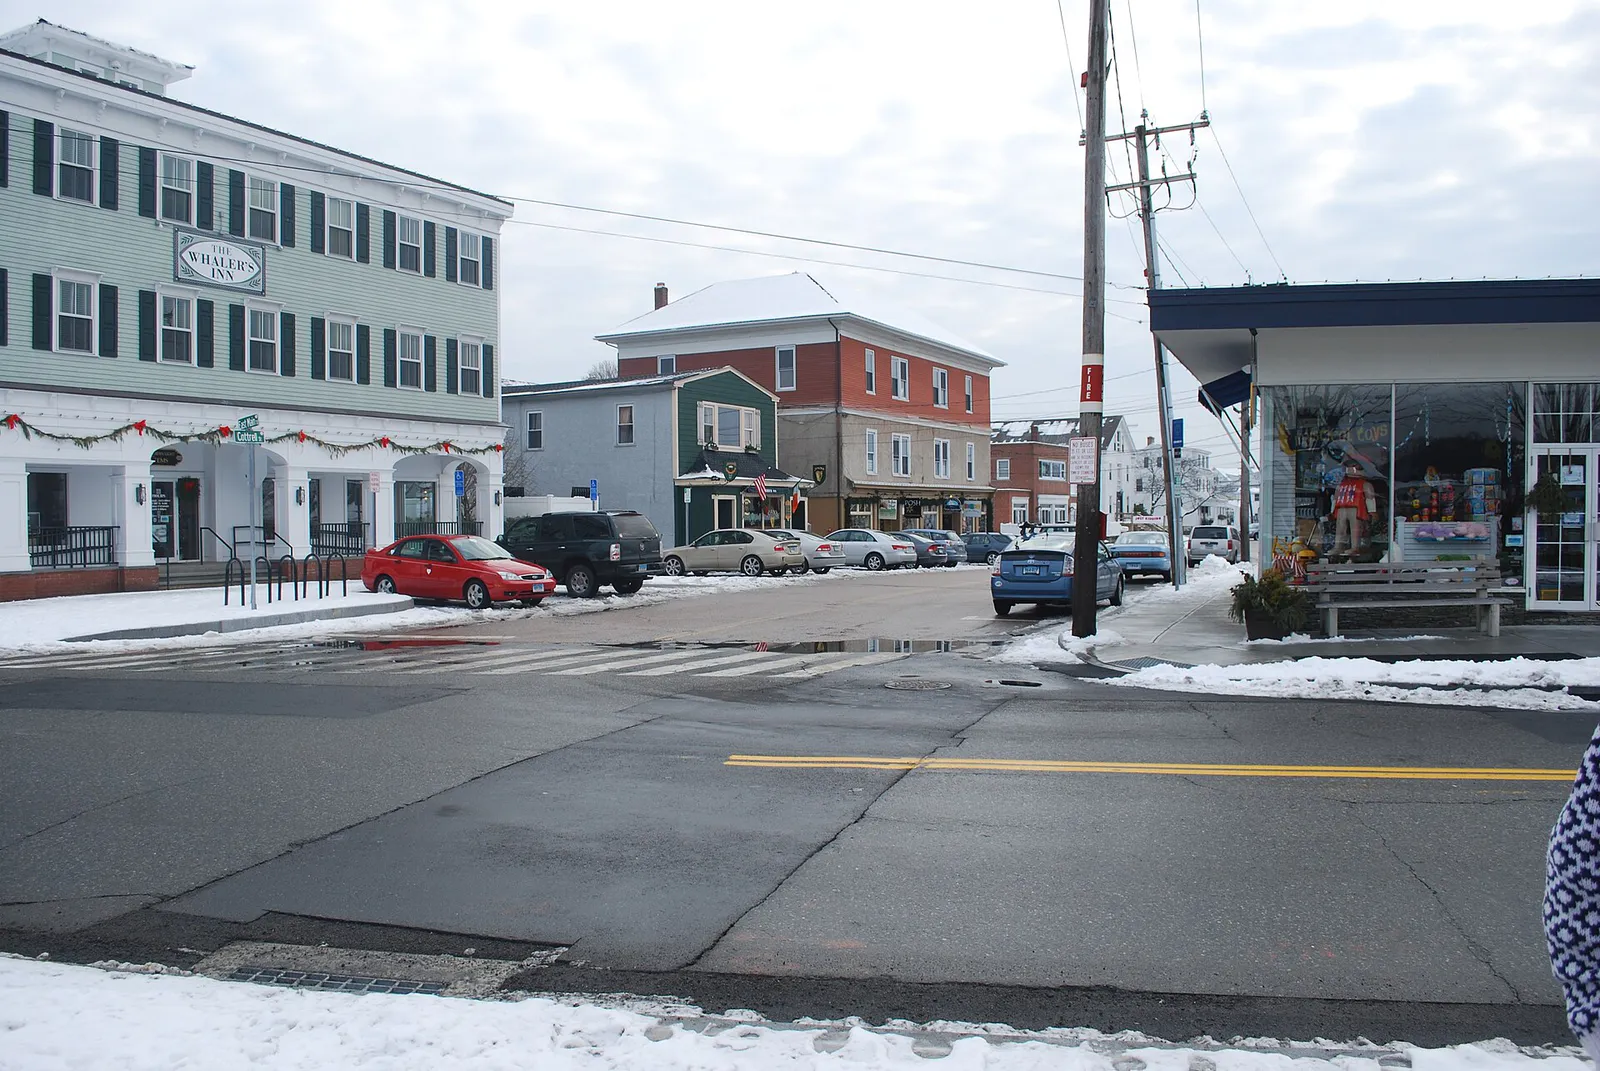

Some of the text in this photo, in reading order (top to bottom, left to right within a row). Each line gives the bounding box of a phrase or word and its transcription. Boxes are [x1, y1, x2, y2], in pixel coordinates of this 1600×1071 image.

[211, 244, 232, 256] THE
[188, 251, 255, 273] WHALER'S
[211, 268, 234, 281] INN
[247, 418, 256, 427] Main
[237, 432, 258, 442] Cottrell
